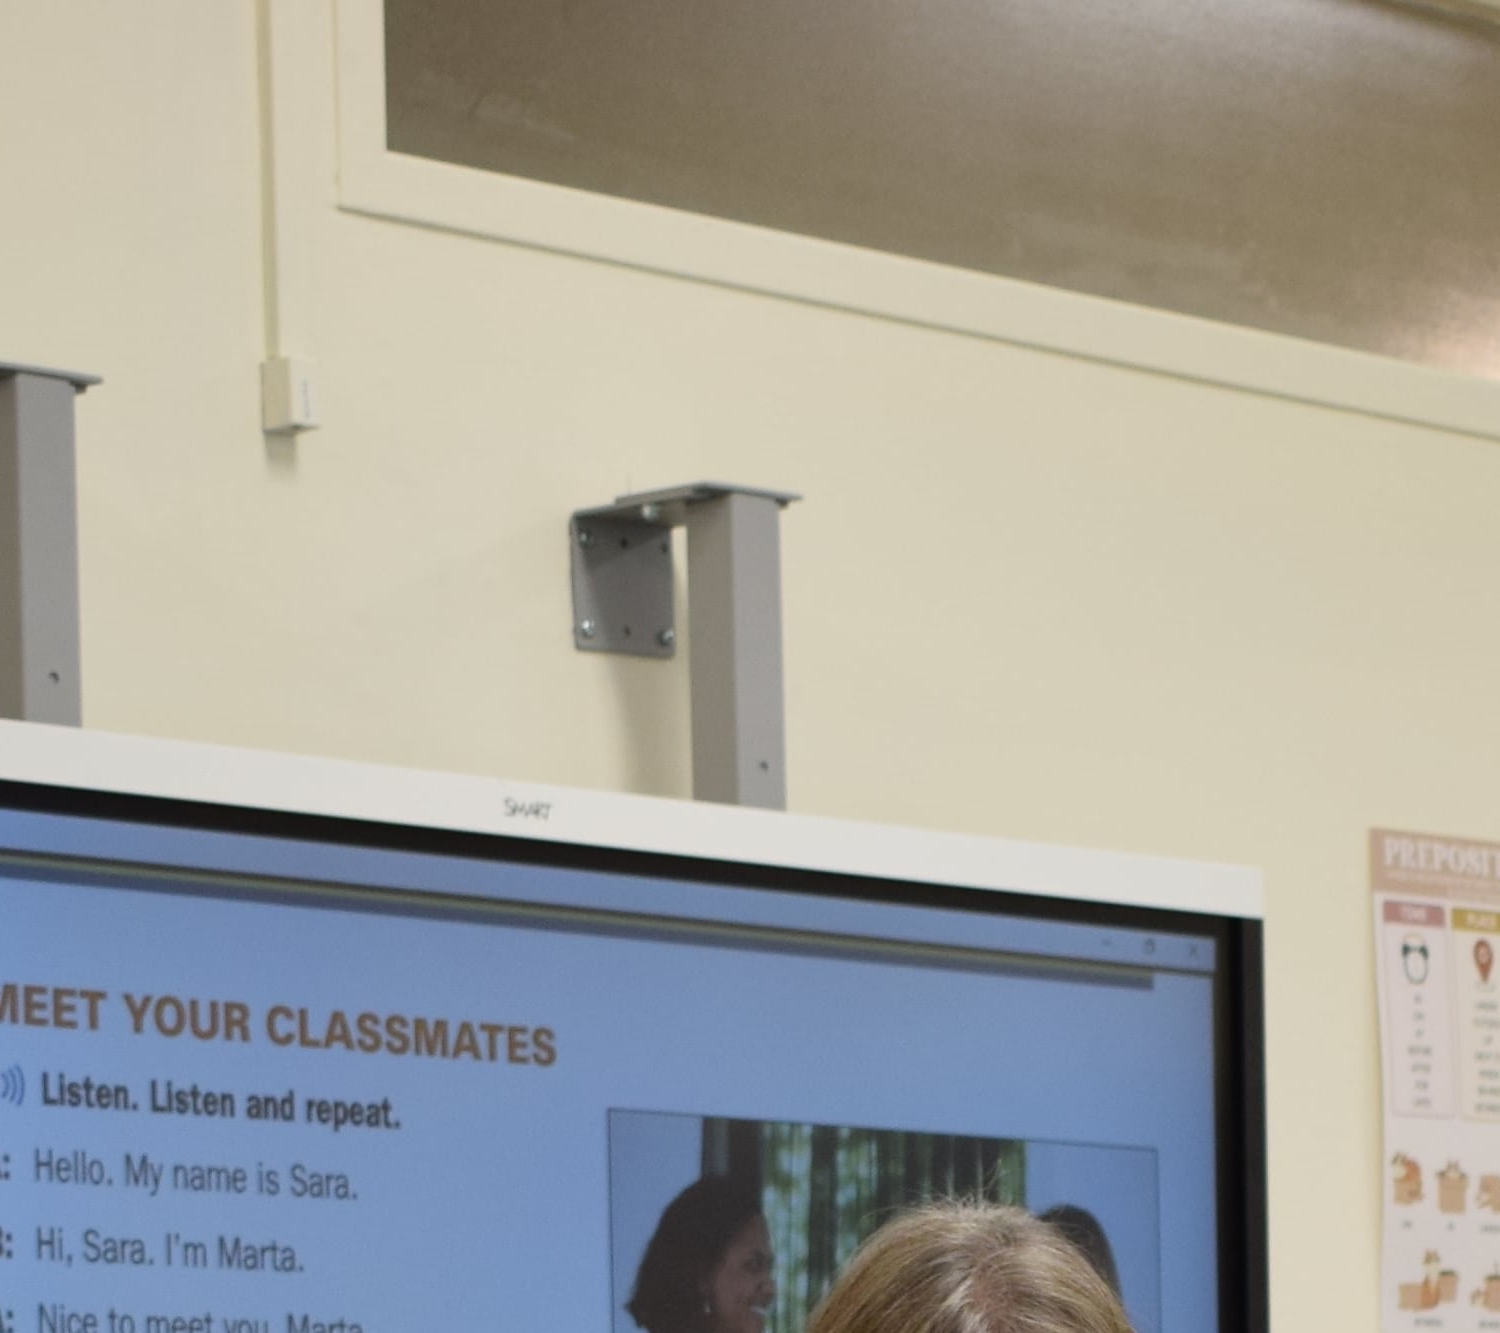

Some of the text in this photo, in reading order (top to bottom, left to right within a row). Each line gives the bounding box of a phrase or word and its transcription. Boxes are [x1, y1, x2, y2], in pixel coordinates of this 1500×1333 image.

[121, 992, 251, 1043] YOUR
[265, 1005, 557, 1068] CLASSMATES
[41, 1071, 401, 1133] Listen. Listen and repeat.
[34, 1147, 113, 1187] Hello.
[123, 1152, 164, 1197] My
[172, 1164, 248, 1195] name
[257, 1161, 281, 1197] is
[289, 1162, 358, 1201] Sara.
[35, 1226, 74, 1267] Hi,
[82, 1228, 154, 1266] Sara.
[165, 1232, 208, 1268] I'm
[217, 1235, 304, 1273] Marta.
